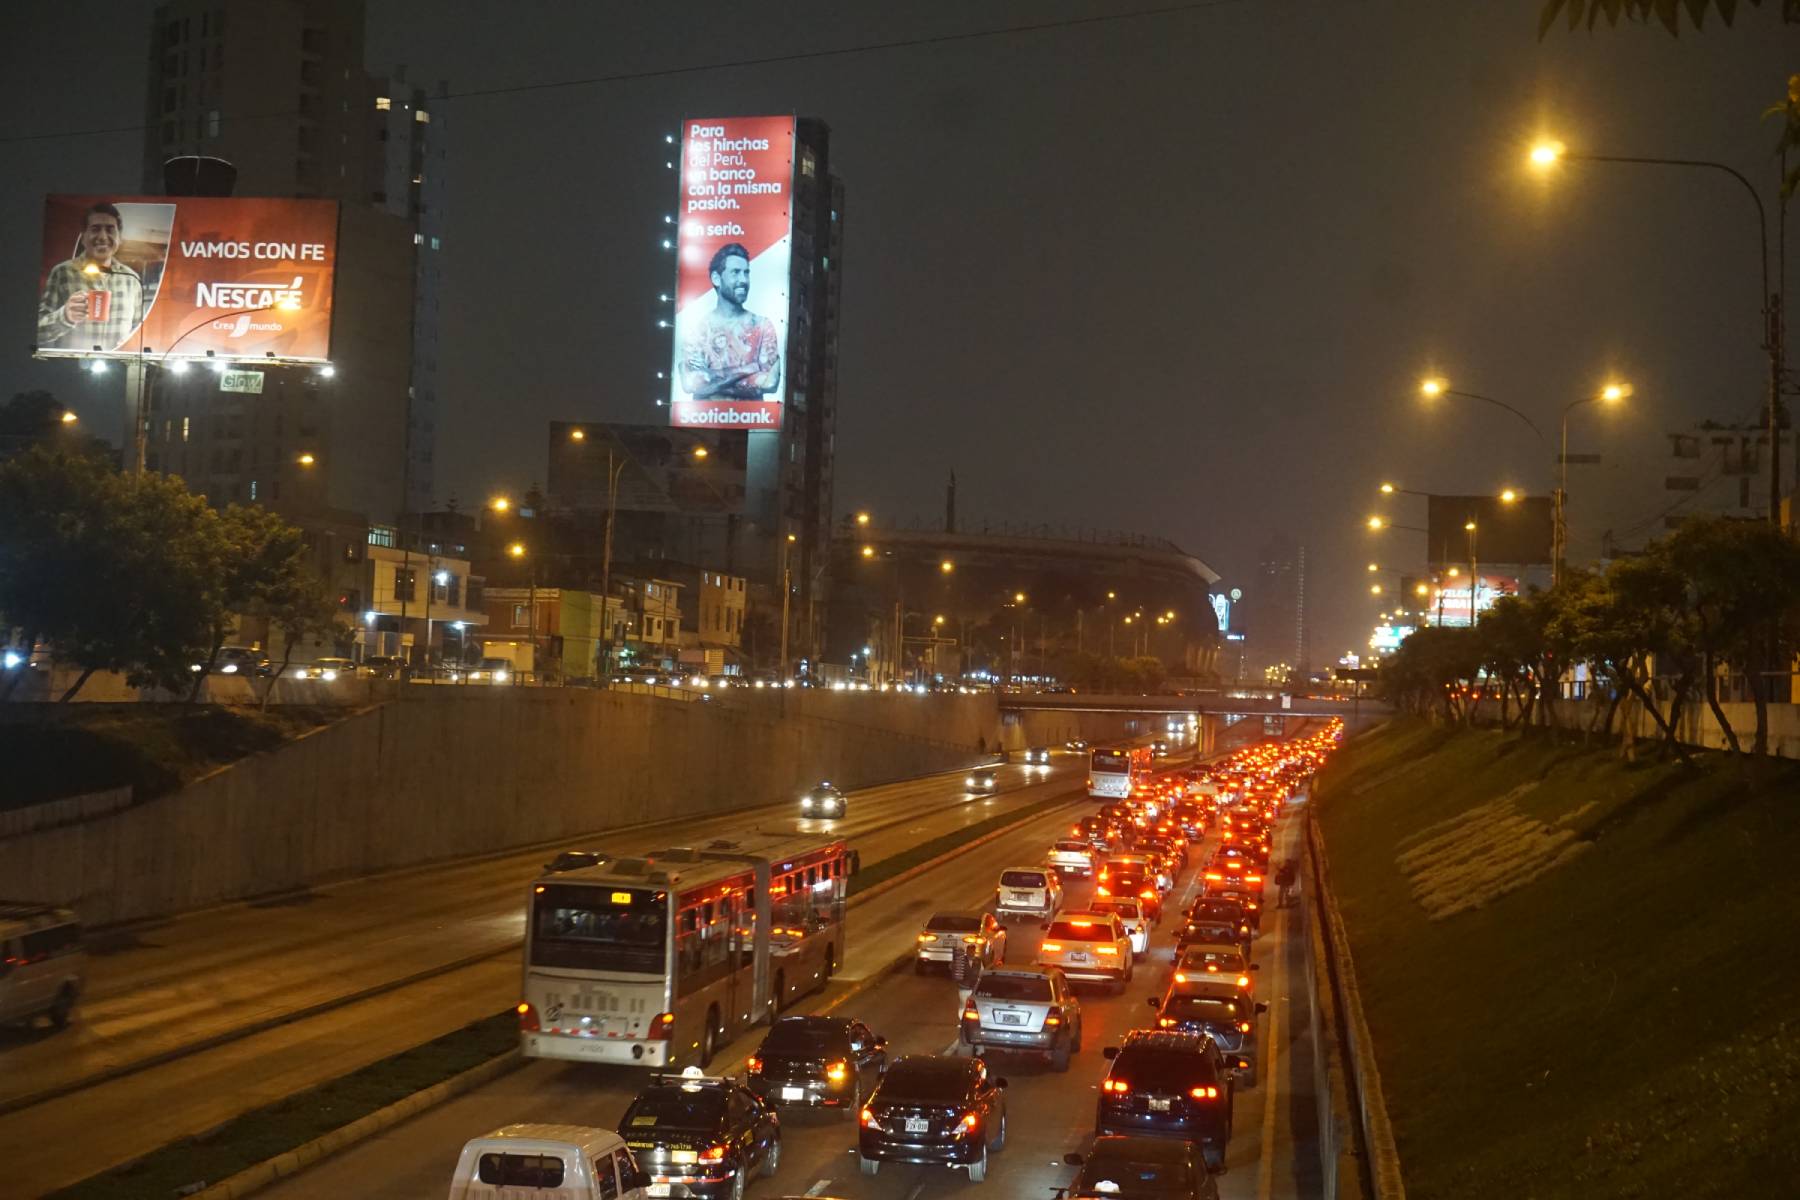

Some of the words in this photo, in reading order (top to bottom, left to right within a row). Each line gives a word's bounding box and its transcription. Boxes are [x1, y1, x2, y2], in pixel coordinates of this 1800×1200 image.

[691, 125, 724, 137] Para
[713, 138, 769, 151] hinchas
[713, 151, 747, 167] Perú,
[710, 167, 756, 181] banco
[688, 184, 715, 196] con
[717, 182, 731, 195] la
[734, 181, 782, 194] misma
[688, 196, 740, 214] pasión.
[707, 221, 745, 236] serio.
[180, 241, 250, 259] VAMOS
[254, 242, 296, 260] CON
[301, 243, 326, 261] FE
[212, 321, 235, 331] Crea
[249, 320, 283, 331] mundo
